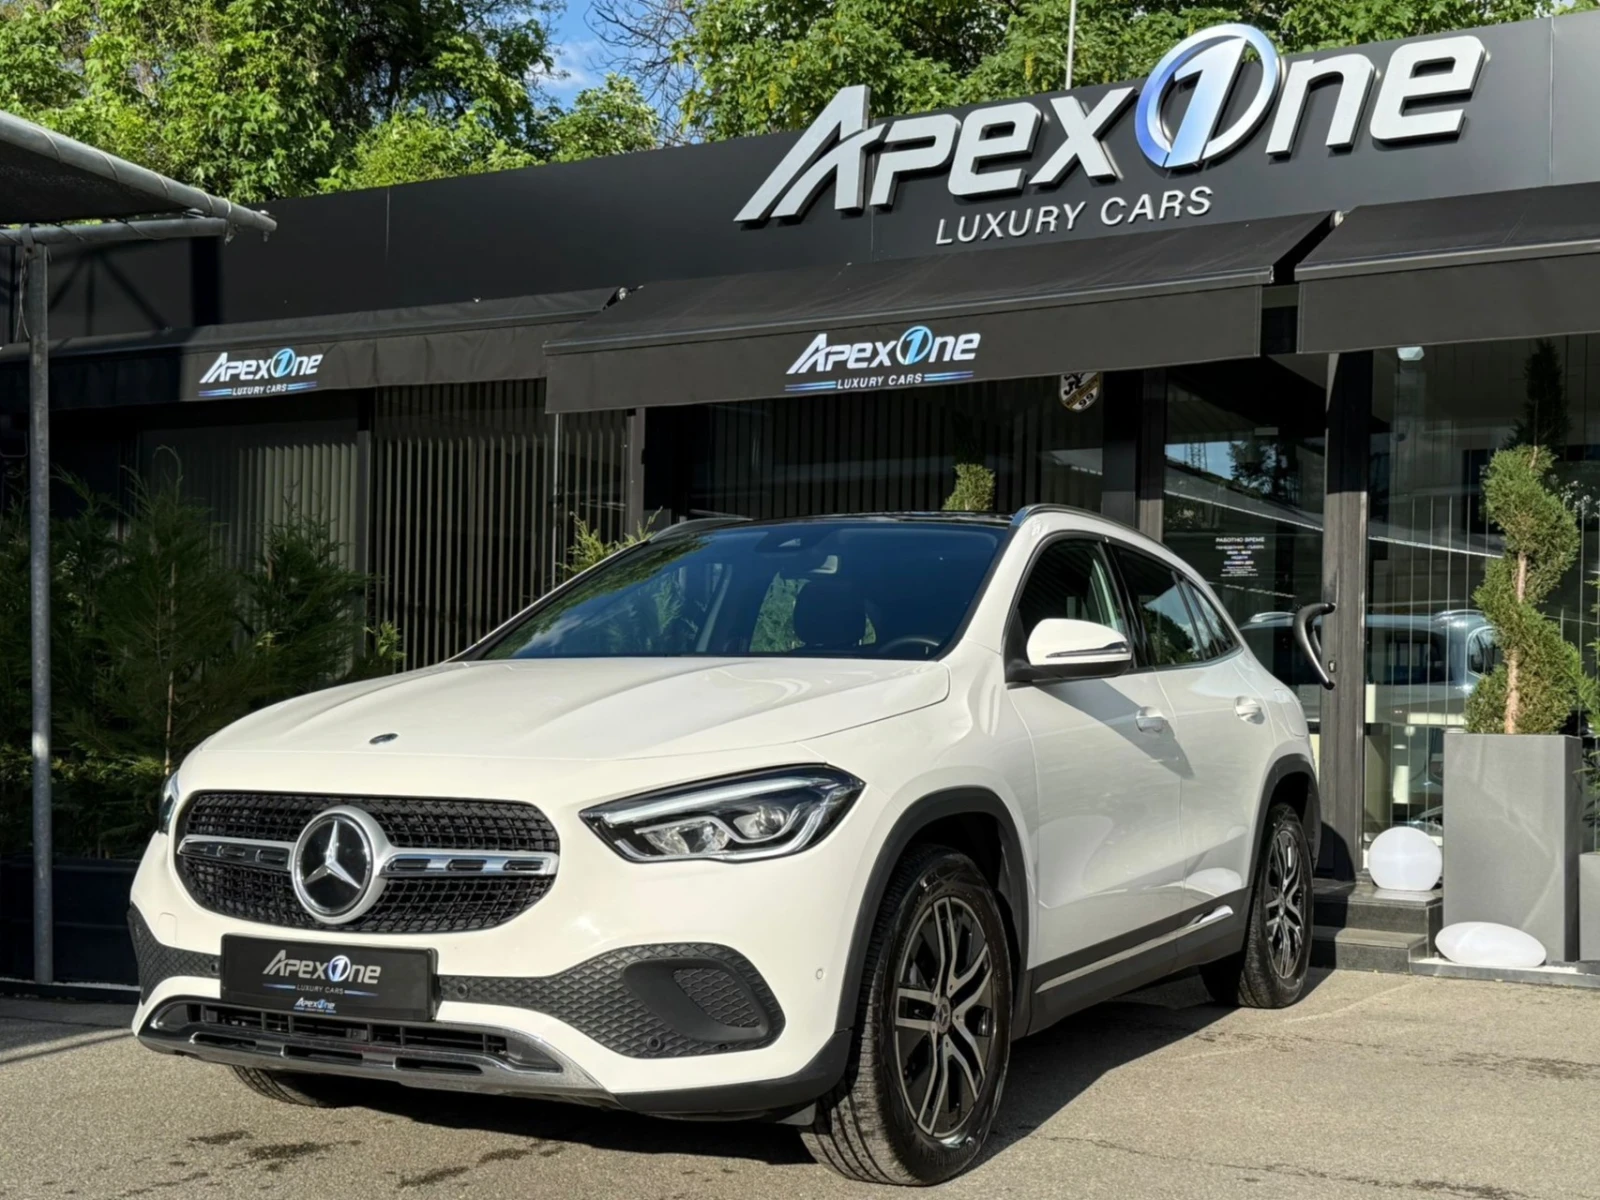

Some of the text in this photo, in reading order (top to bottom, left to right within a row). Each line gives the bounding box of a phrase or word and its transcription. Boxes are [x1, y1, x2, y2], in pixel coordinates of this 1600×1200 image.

[936, 186, 1213, 246] LUXURY CARS
[837, 373, 923, 390] LUXURY CARS
[232, 383, 287, 396] LUXURY CARS
[296, 984, 344, 995] LUXURY CARS
